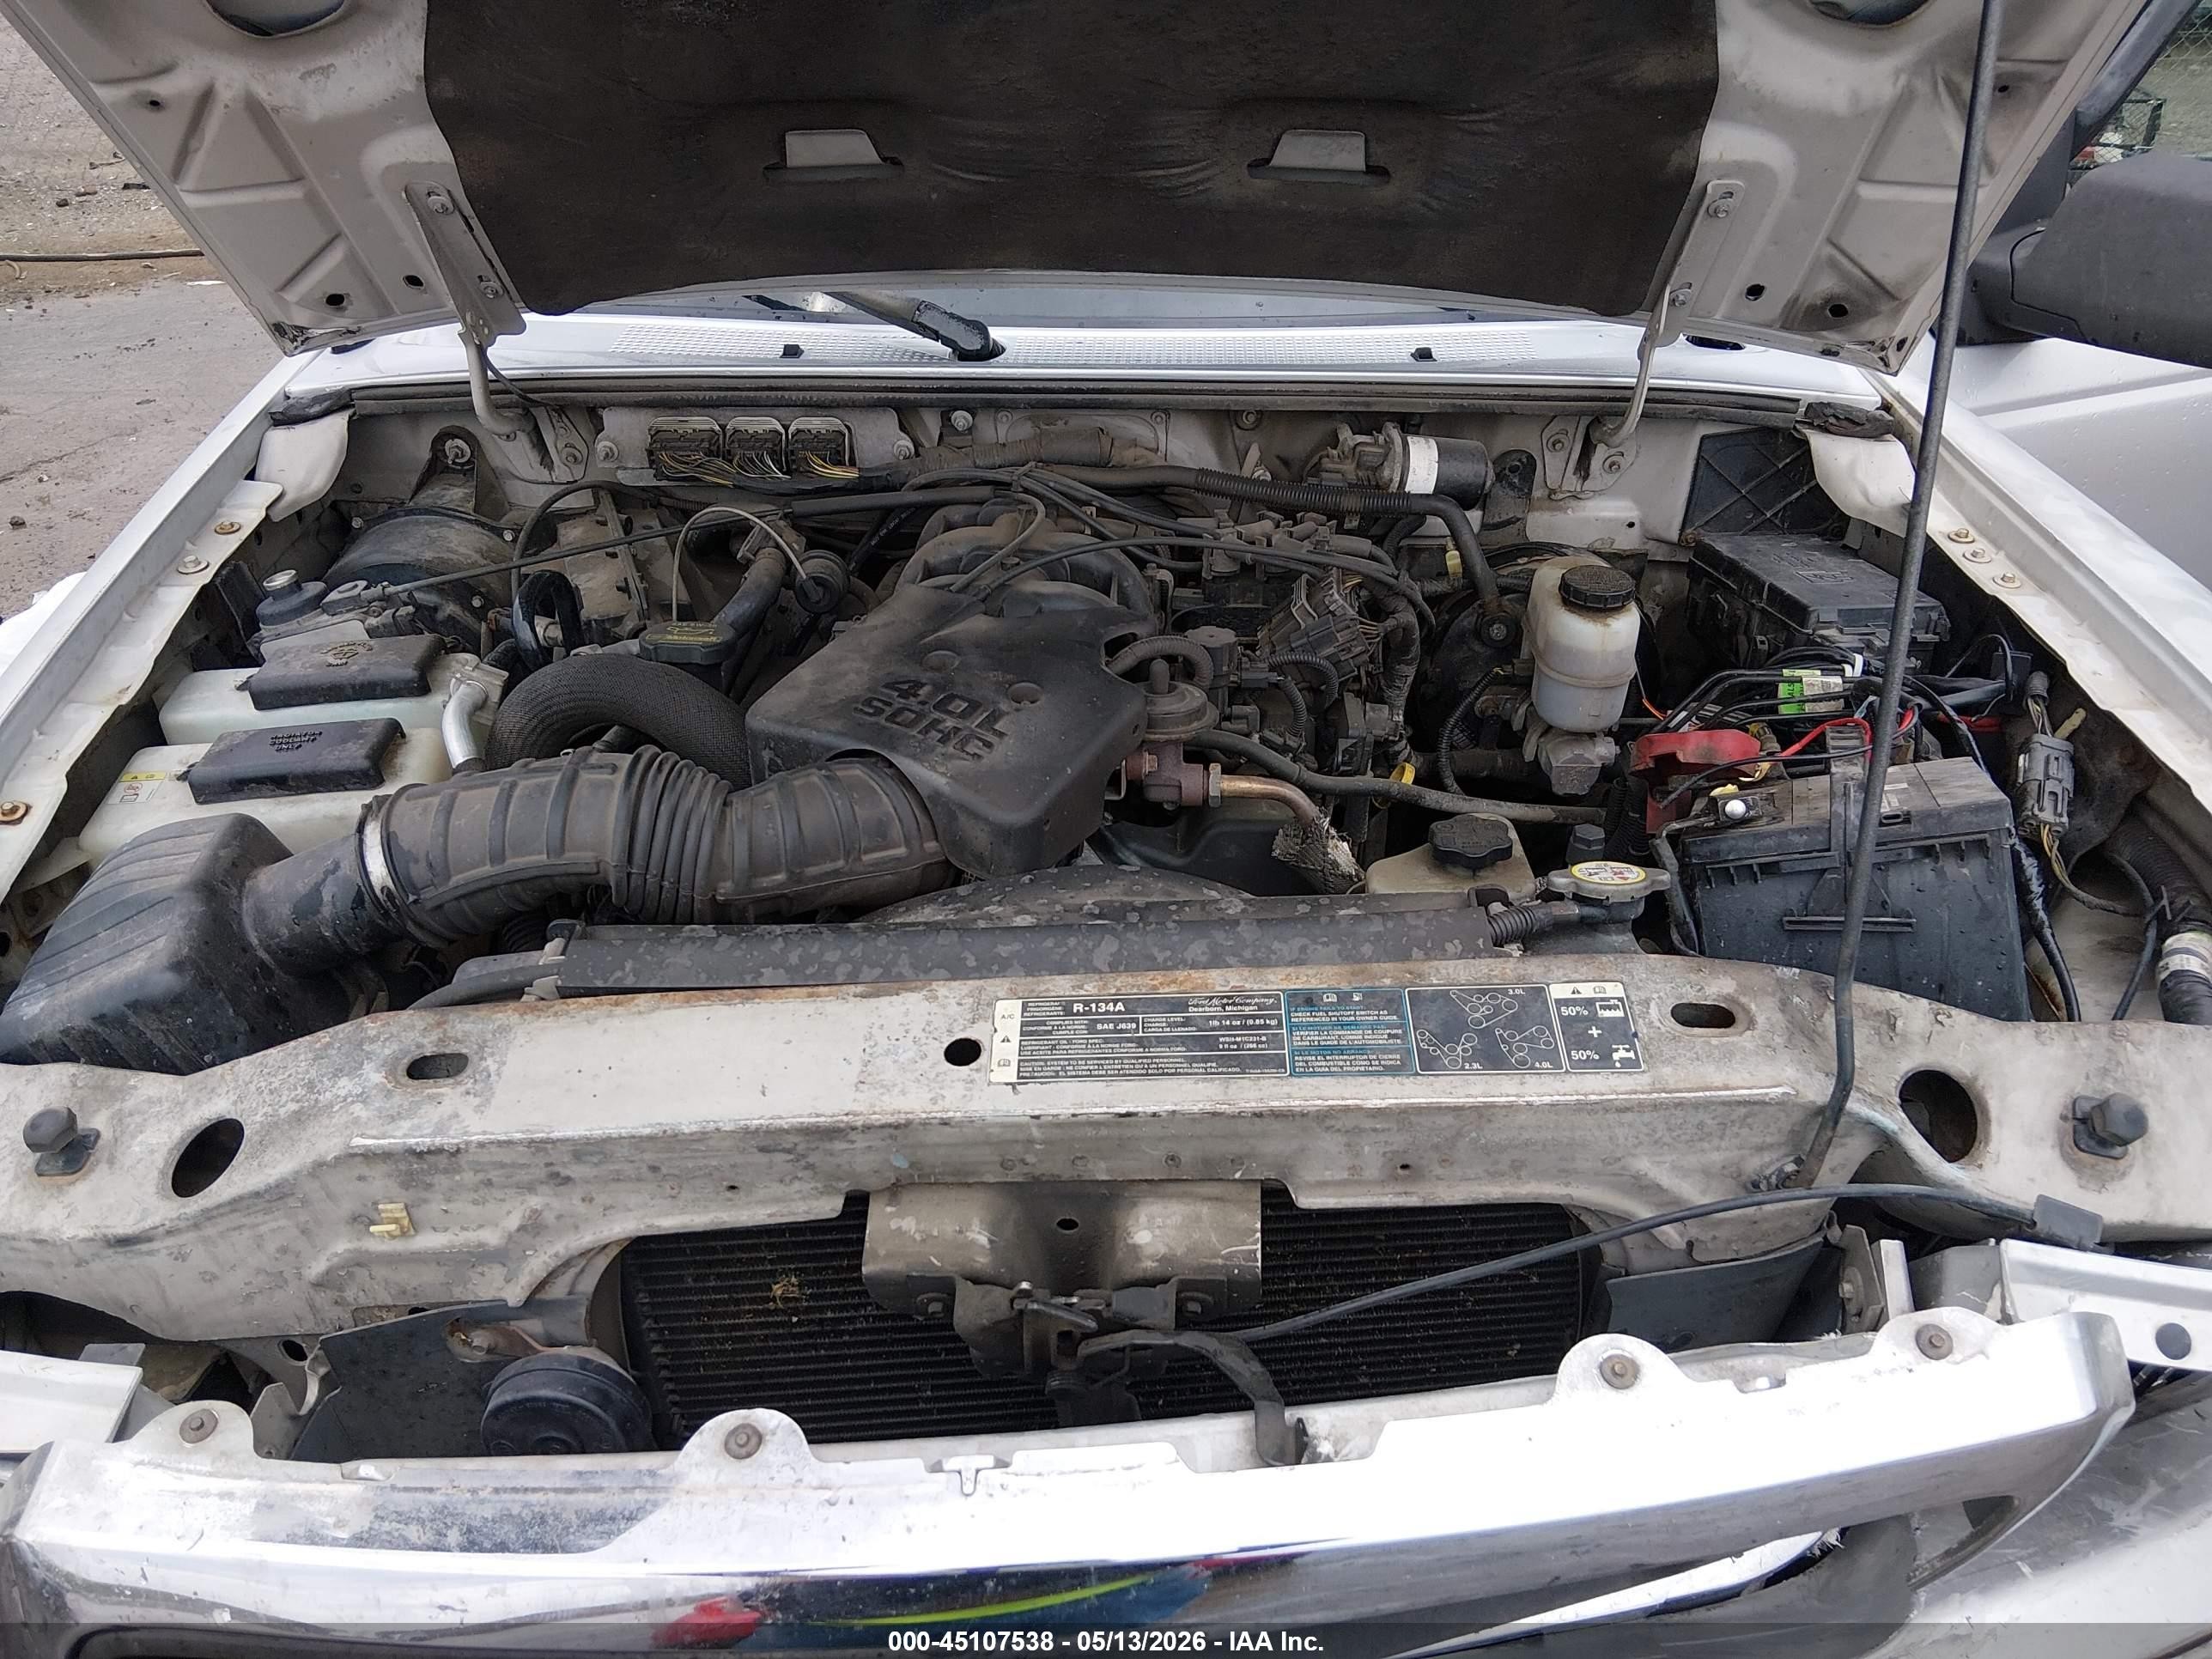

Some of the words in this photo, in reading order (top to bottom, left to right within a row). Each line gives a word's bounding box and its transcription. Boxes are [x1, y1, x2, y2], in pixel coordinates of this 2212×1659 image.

[881, 678, 1009, 739] 4.0L
[853, 696, 997, 763] SOHC
[1073, 1001, 1125, 1013] R-134A
[1225, 1004, 1258, 1012] Michigan
[1560, 1006, 1589, 1016] 50%
[1266, 1018, 1278, 1026] kg)
[1571, 1050, 1600, 1060] 50%
